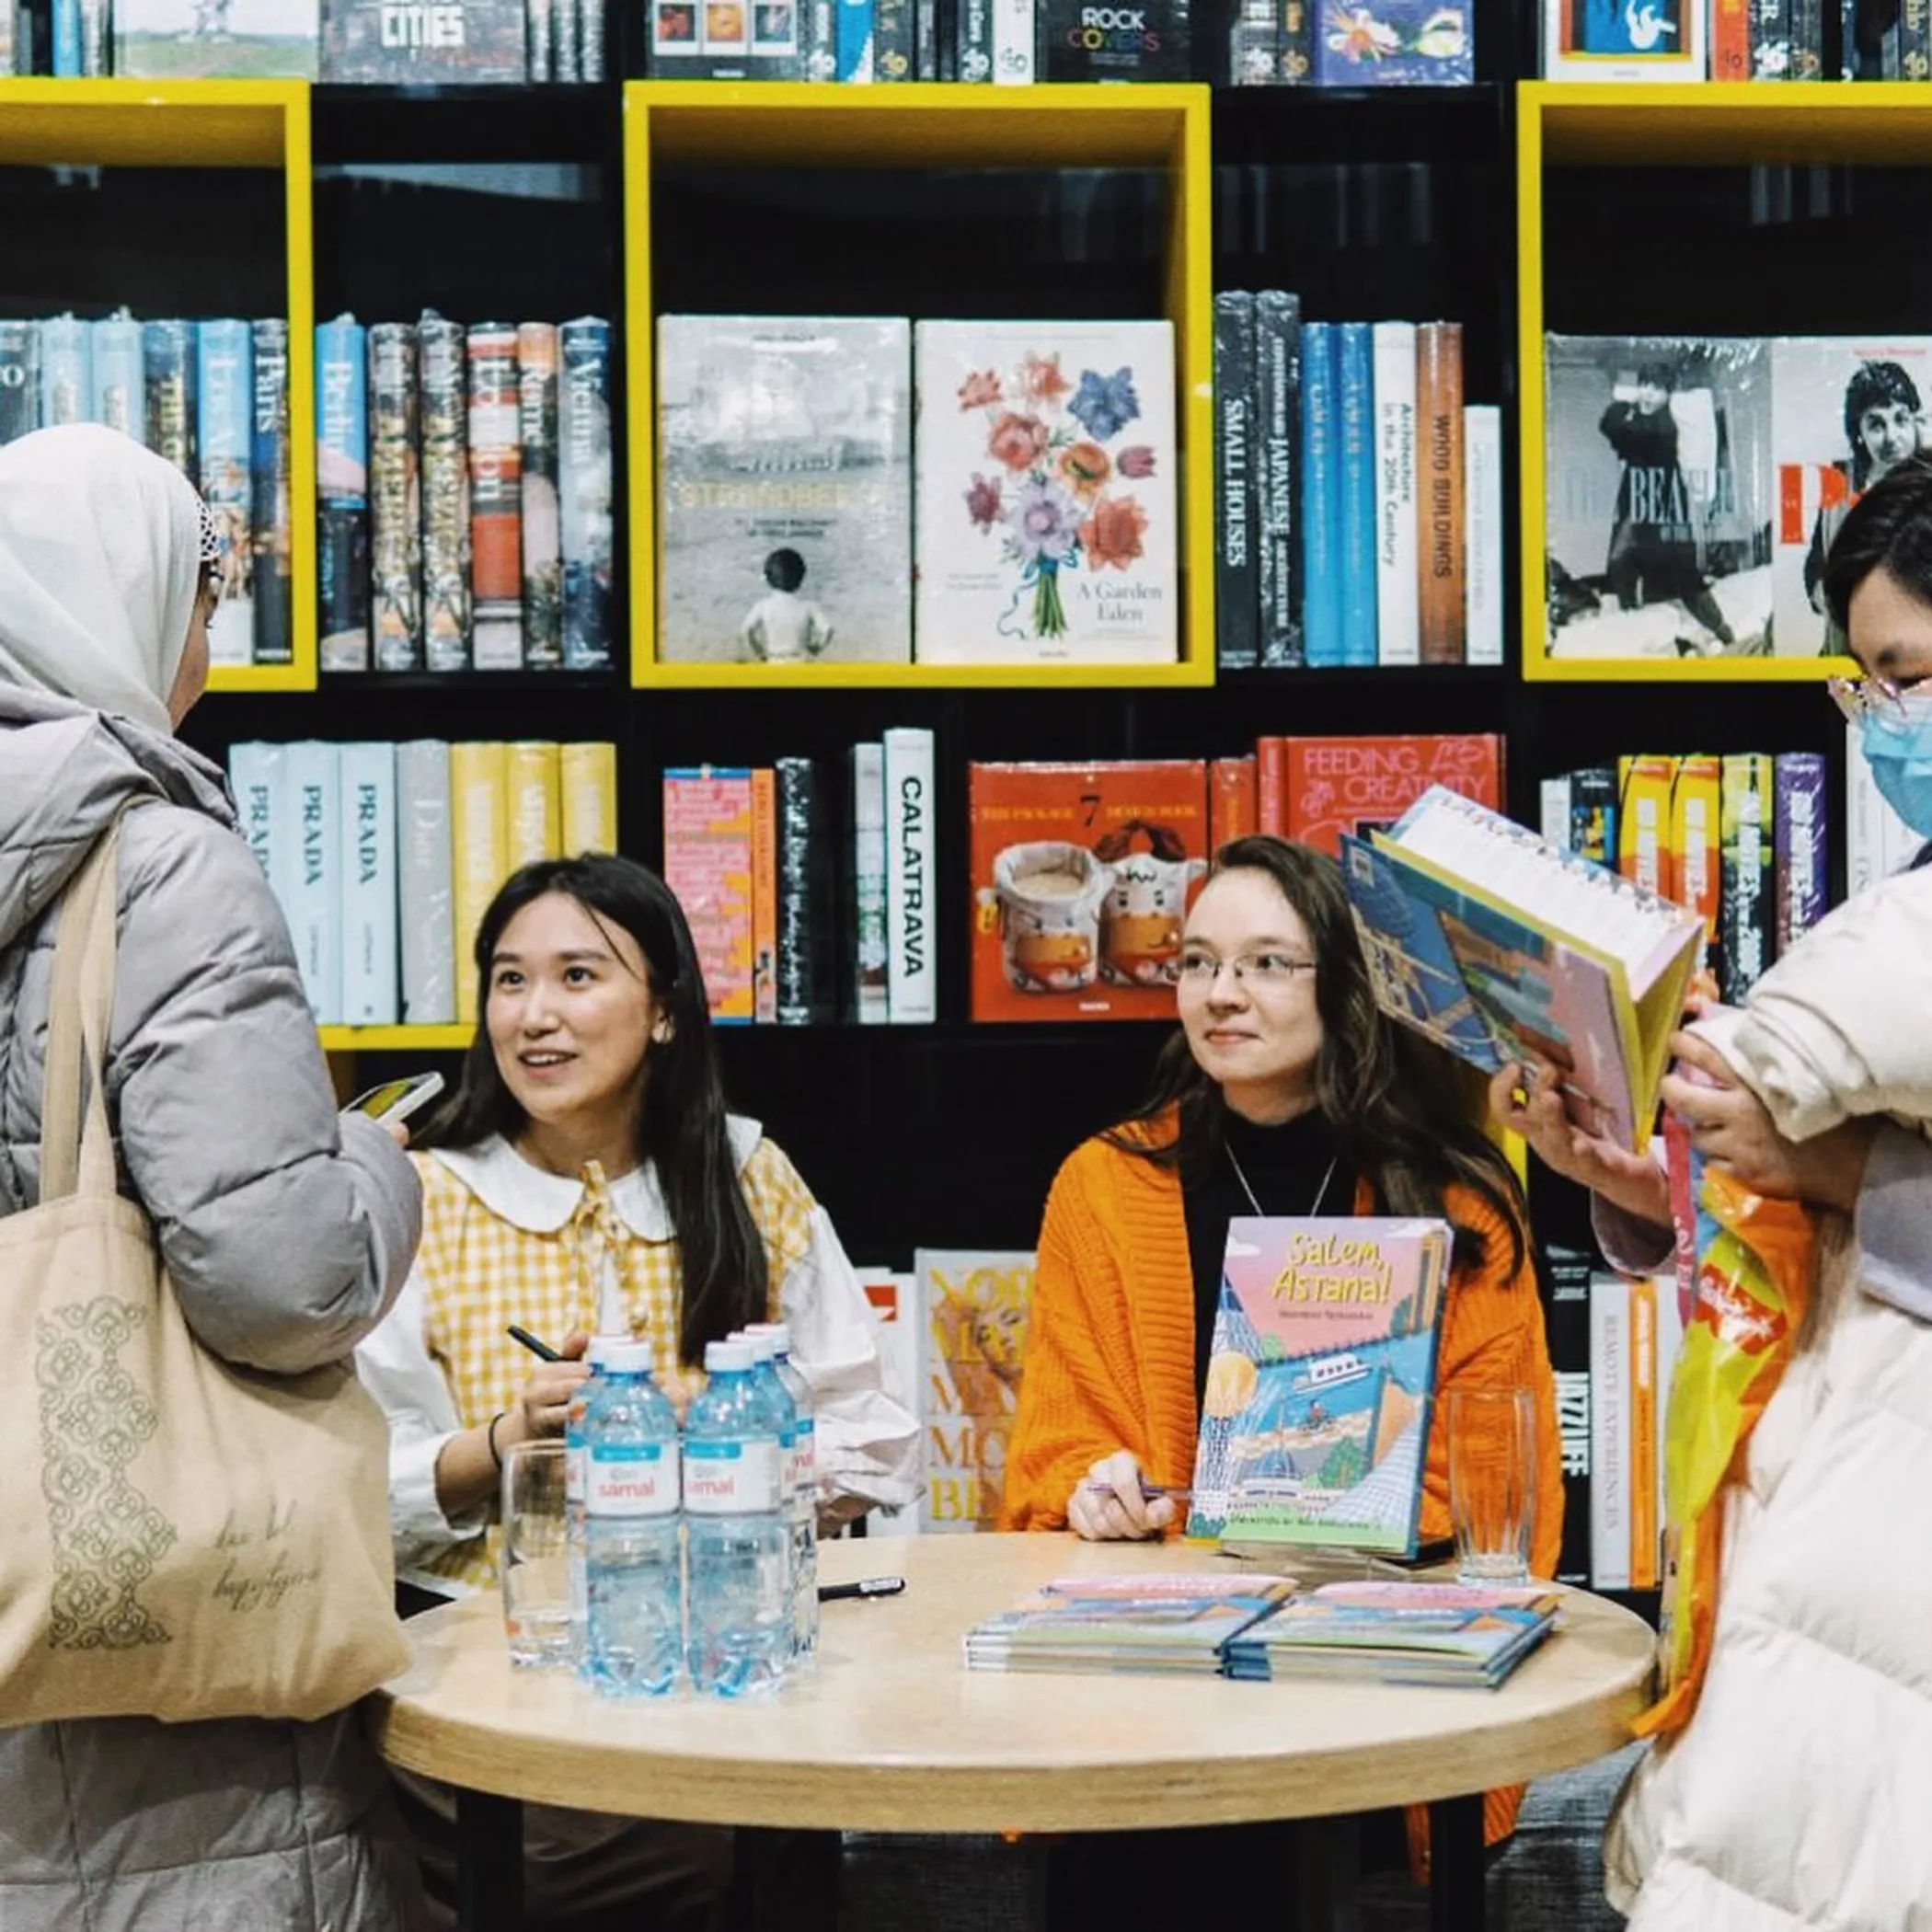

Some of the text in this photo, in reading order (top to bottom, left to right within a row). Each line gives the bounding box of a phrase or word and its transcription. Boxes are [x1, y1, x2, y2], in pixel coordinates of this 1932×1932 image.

[1080, 6, 1145, 30] ROCK
[255, 355, 288, 433] Paris
[322, 362, 357, 453] Berlin
[471, 359, 512, 502] London
[521, 359, 554, 447] Rome
[568, 358, 603, 464] Vienna
[1224, 398, 1247, 568] SMALL HOUSES
[1269, 438, 1290, 535] JAPANESE
[1377, 403, 1398, 567] in the 20th Century
[1400, 403, 1413, 503] Architecture
[1432, 414, 1453, 580] WOOD BUILDINGS
[1095, 580, 1162, 602] Garden
[1097, 602, 1144, 622] Eden
[1303, 746, 1420, 776] FEEDING
[249, 785, 270, 880] PRAD
[303, 785, 323, 886] PRADA
[357, 784, 378, 885] PRADA
[1079, 794, 1101, 828] 7
[901, 776, 924, 978] CALATRAVA
[1603, 1315, 1621, 1531] REMOTE EXPERIENCES
